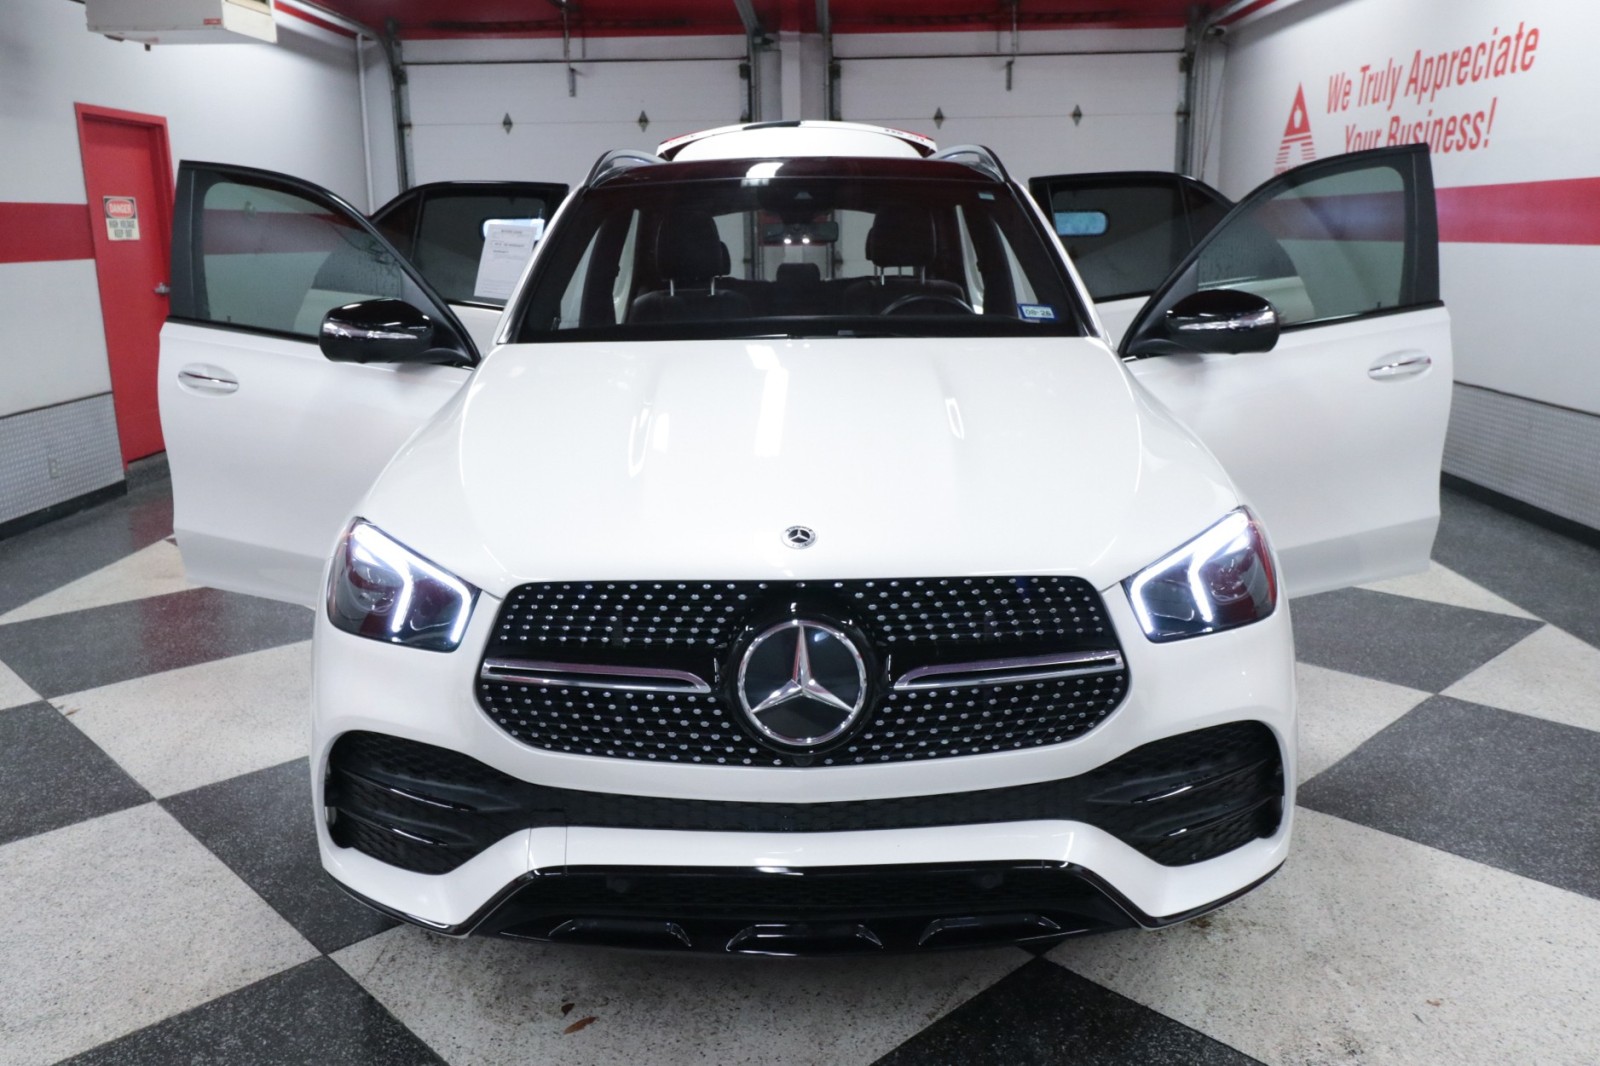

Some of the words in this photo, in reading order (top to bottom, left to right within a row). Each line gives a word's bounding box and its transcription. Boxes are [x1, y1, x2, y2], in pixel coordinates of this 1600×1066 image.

[1326, 72, 1352, 114] We
[1358, 57, 1403, 111] Truly
[1404, 21, 1539, 105] Appreciate
[1344, 123, 1382, 153] Your
[1387, 97, 1497, 154] Business!
